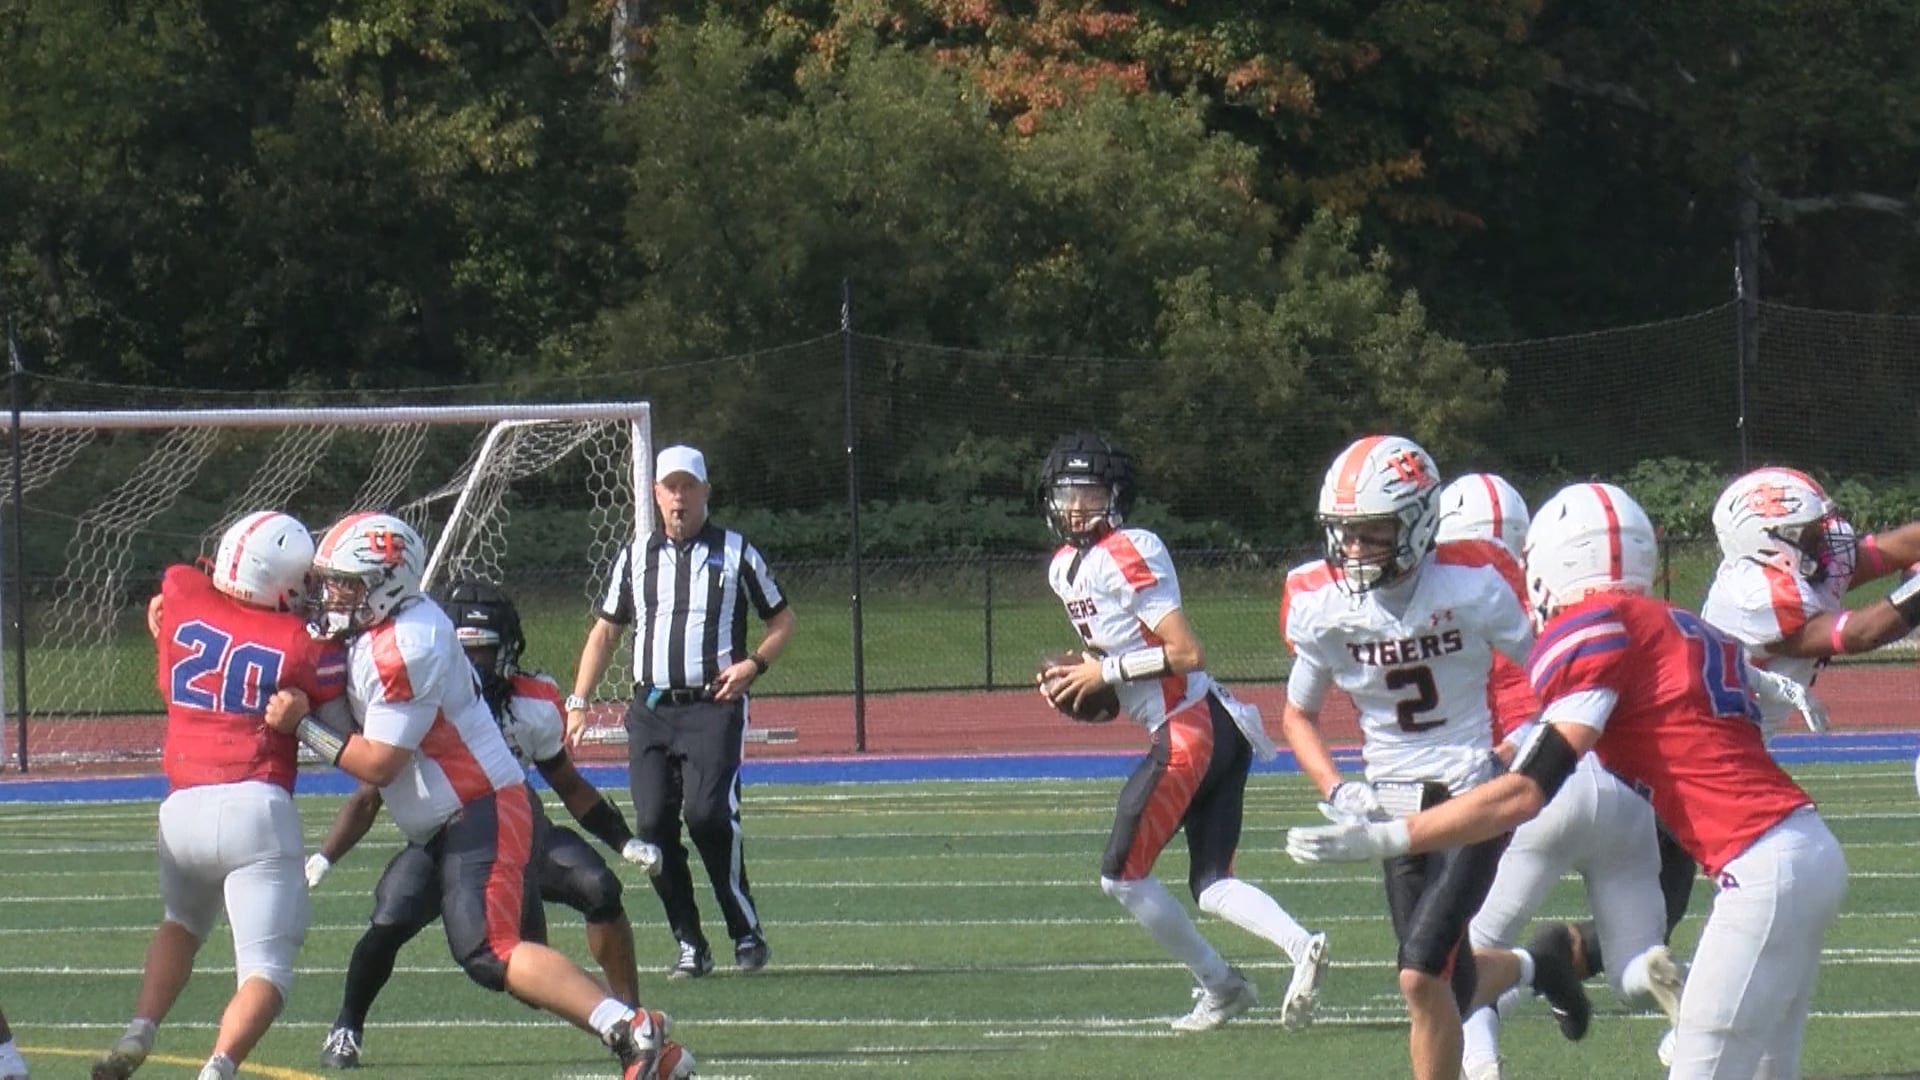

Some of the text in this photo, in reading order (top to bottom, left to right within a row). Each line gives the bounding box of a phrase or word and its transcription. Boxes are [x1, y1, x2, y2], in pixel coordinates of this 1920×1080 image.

[171, 619, 285, 714] 20
[1346, 629, 1464, 667] TIGERS
[1384, 664, 1449, 732] 2
